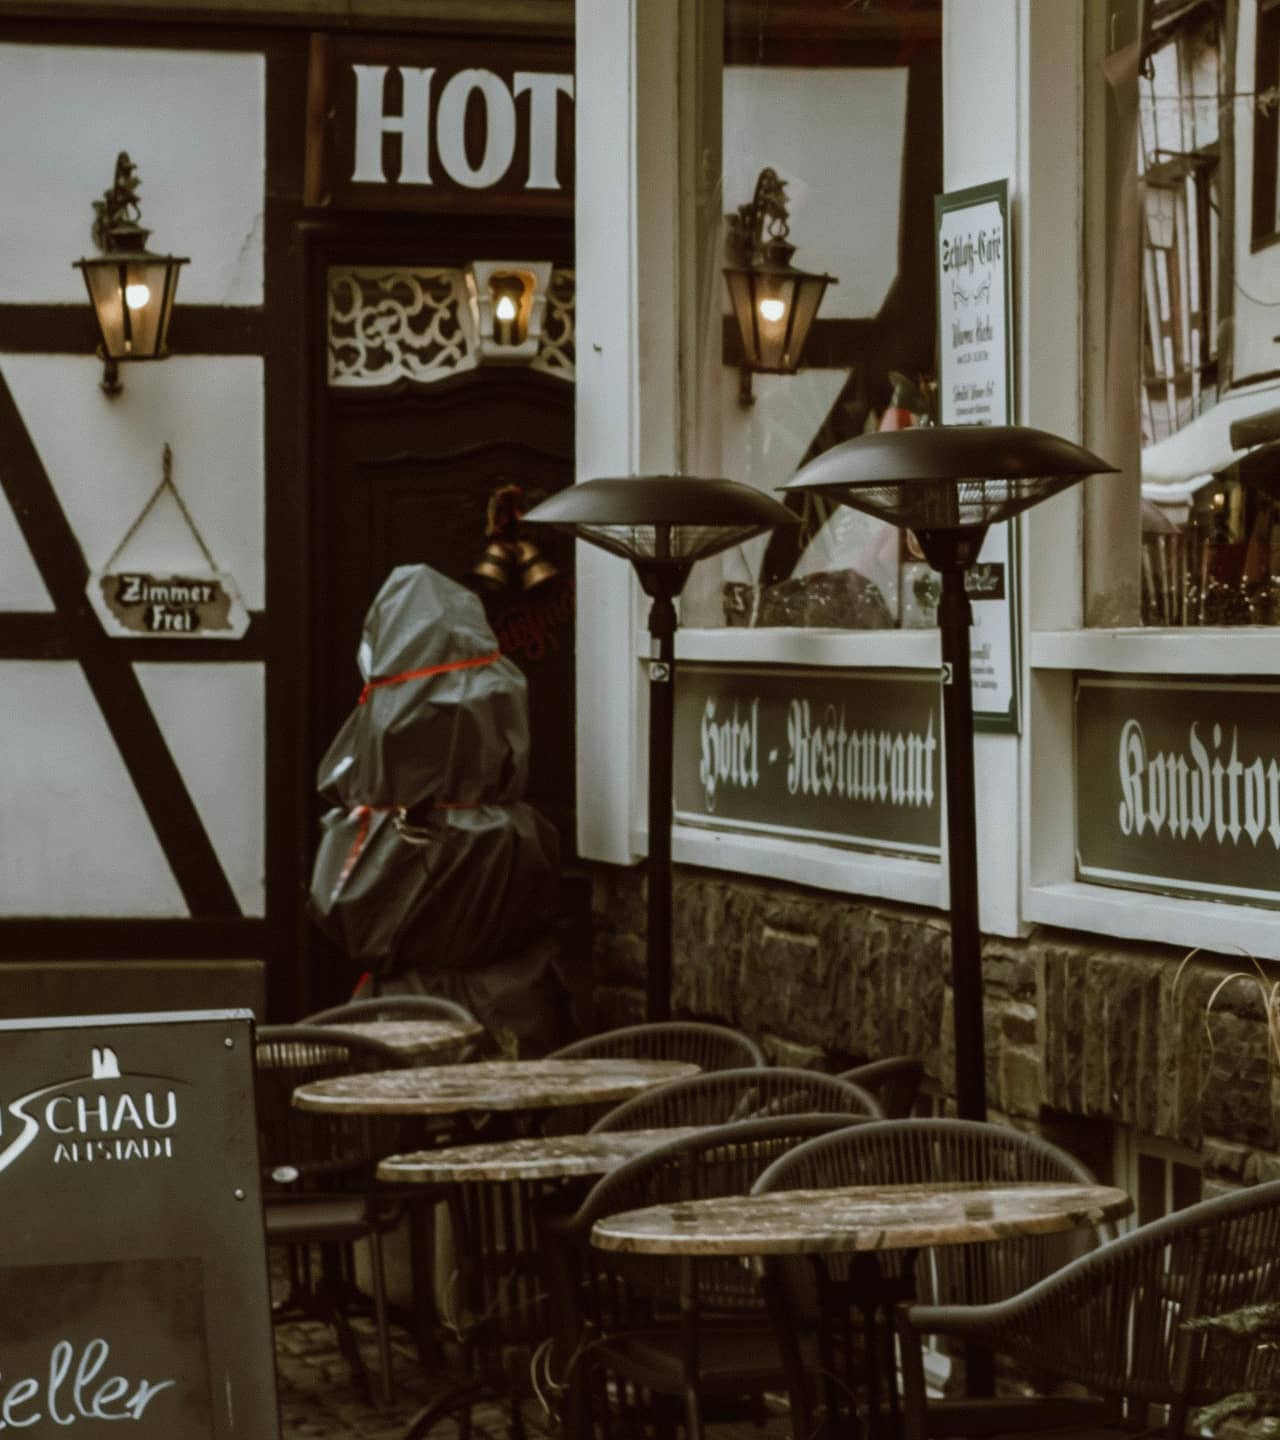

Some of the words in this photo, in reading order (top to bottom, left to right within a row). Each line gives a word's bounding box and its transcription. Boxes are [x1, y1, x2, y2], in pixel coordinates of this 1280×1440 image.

[121, 576, 211, 602] Zimmer
[152, 604, 191, 631] Frei
[700, 696, 760, 812] Hotel
[787, 697, 937, 808] Restaurant
[0, 1073, 177, 1171] SCHAU
[0, 1338, 177, 1429] eller
